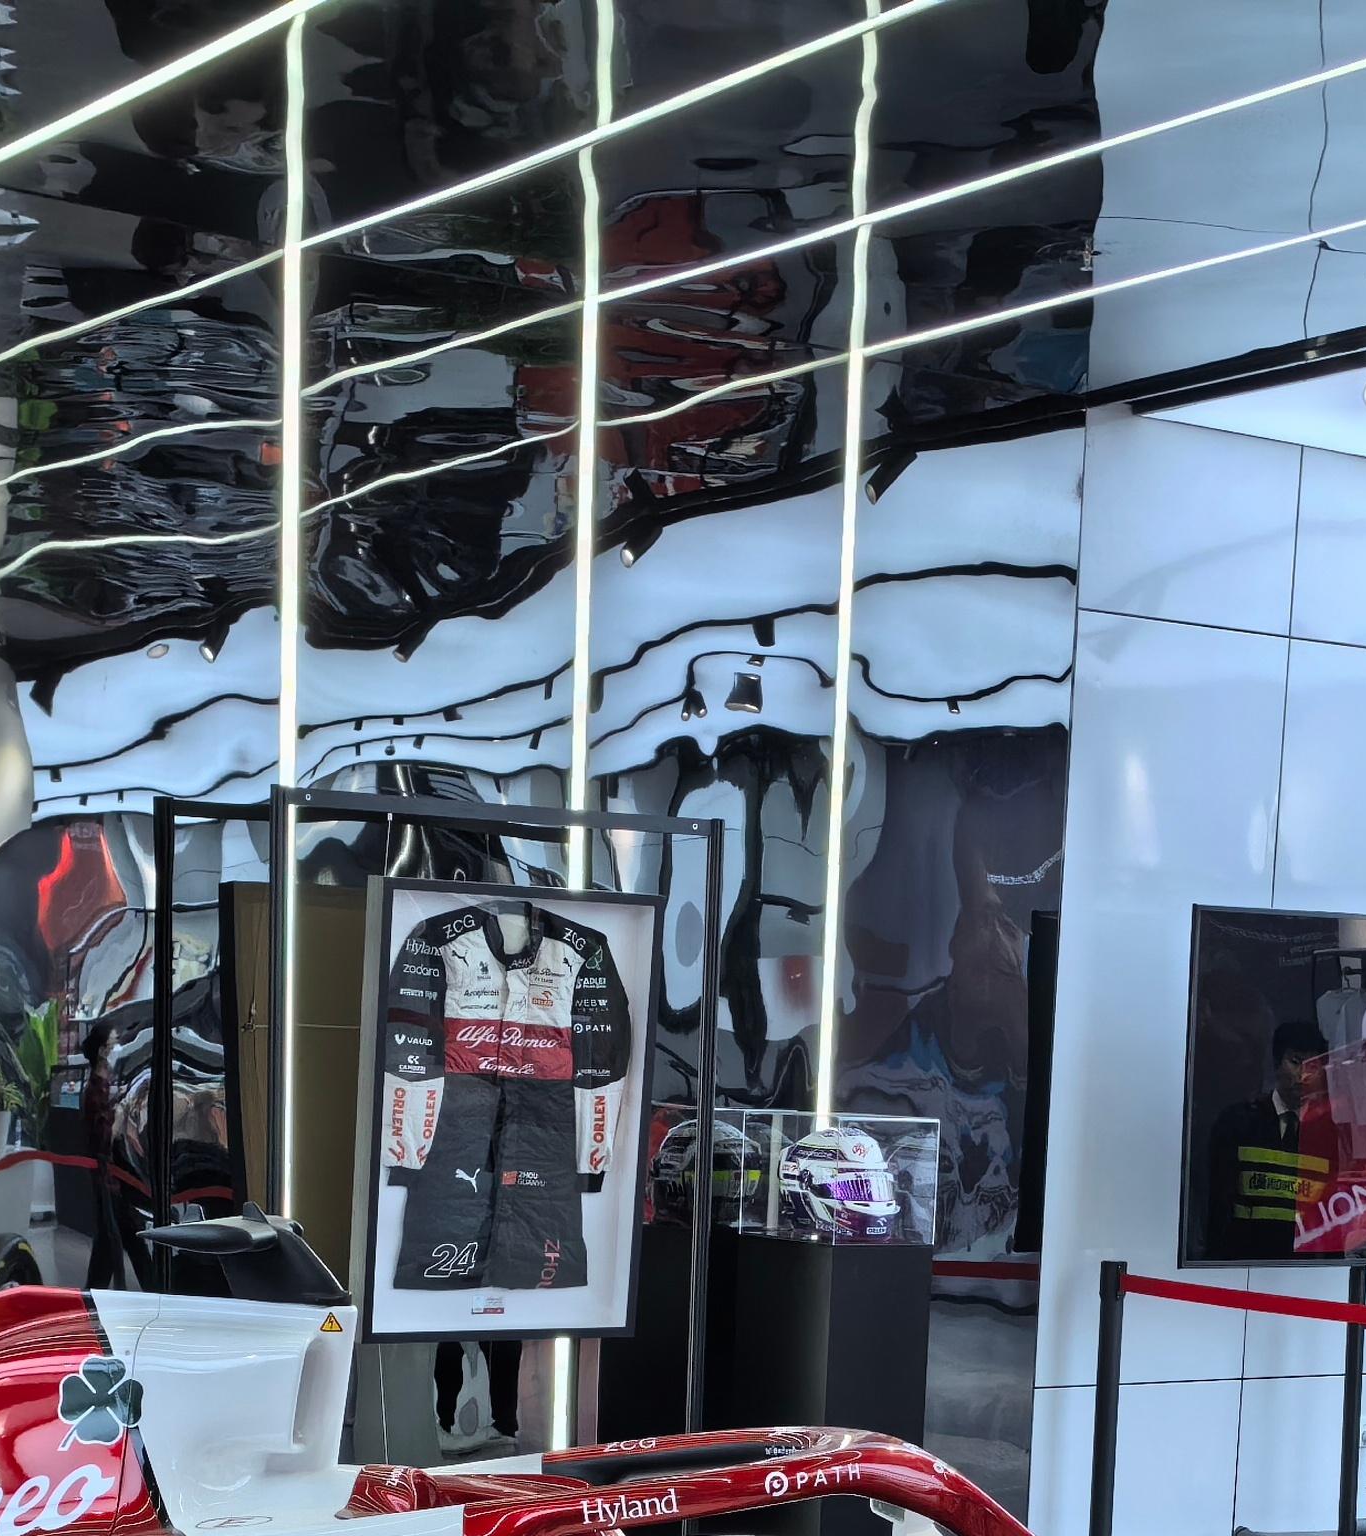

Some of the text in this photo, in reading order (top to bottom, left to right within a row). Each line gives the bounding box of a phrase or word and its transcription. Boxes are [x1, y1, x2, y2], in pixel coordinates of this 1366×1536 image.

[442, 914, 475, 939] ZCG
[456, 1025, 558, 1048] Alfa Romeo
[392, 1087, 406, 1137] ORLEN
[423, 1089, 436, 1139] ORLEN
[593, 1096, 605, 1144] ORLEN
[424, 1242, 479, 1278] 24
[797, 1463, 862, 1490] PATH
[580, 1489, 679, 1529] Hyland
